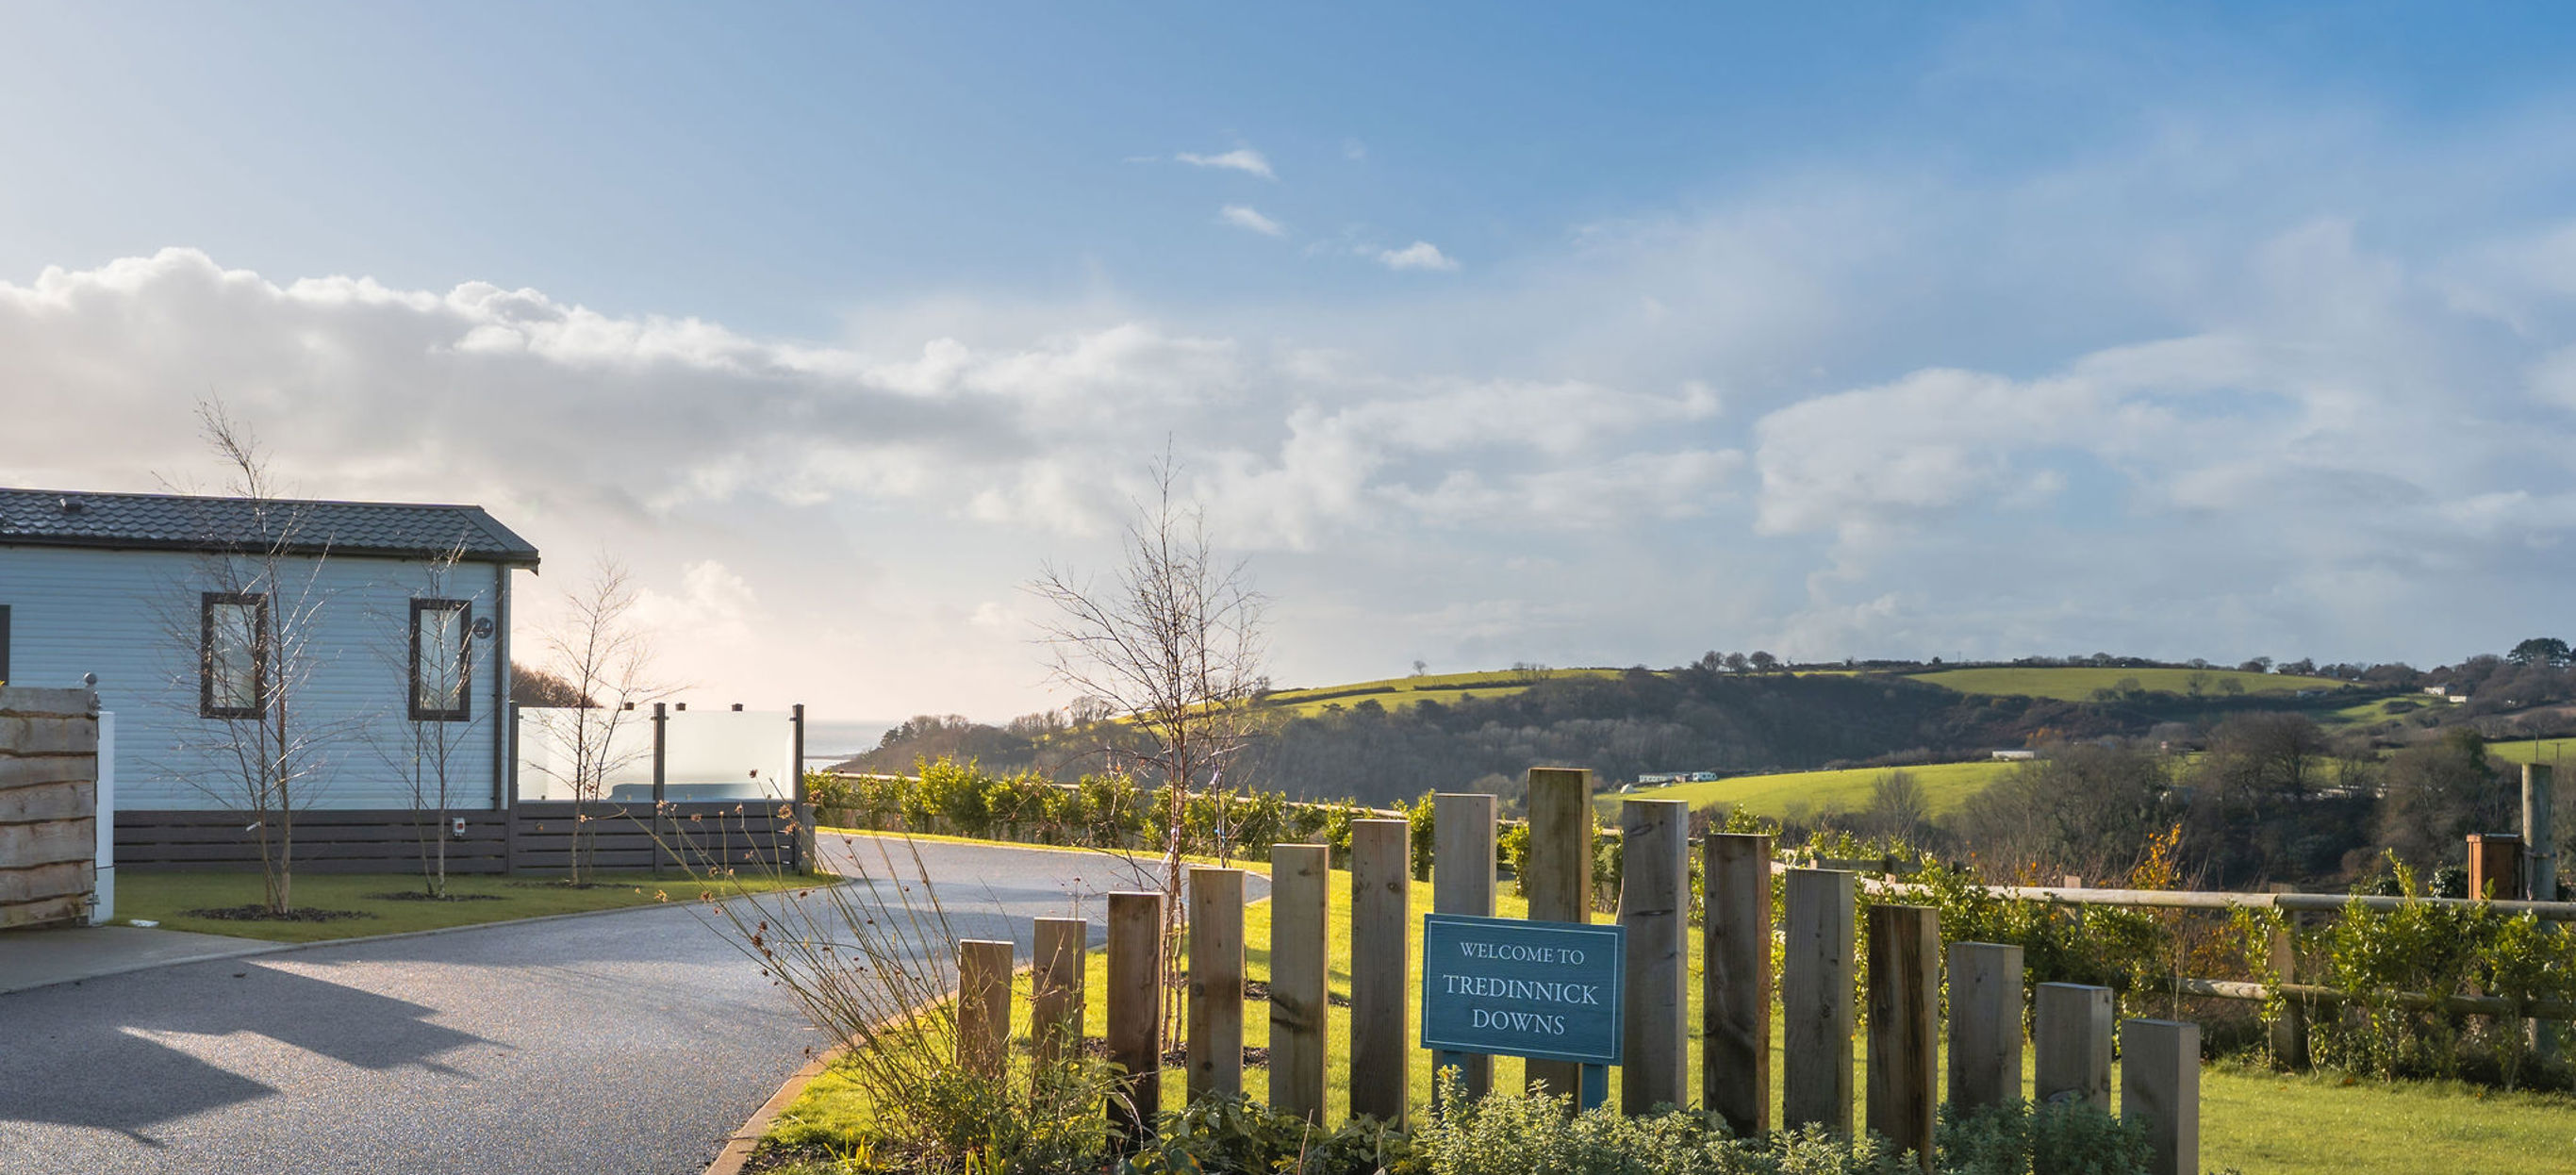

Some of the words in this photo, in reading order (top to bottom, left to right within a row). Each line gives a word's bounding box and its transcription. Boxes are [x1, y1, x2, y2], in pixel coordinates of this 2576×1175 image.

[1460, 941, 1554, 963] WELCOME
[1558, 949, 1585, 965] TO
[1442, 973, 1599, 1005] TREDINNICK
[1472, 1009, 1565, 1035] DOWNS
